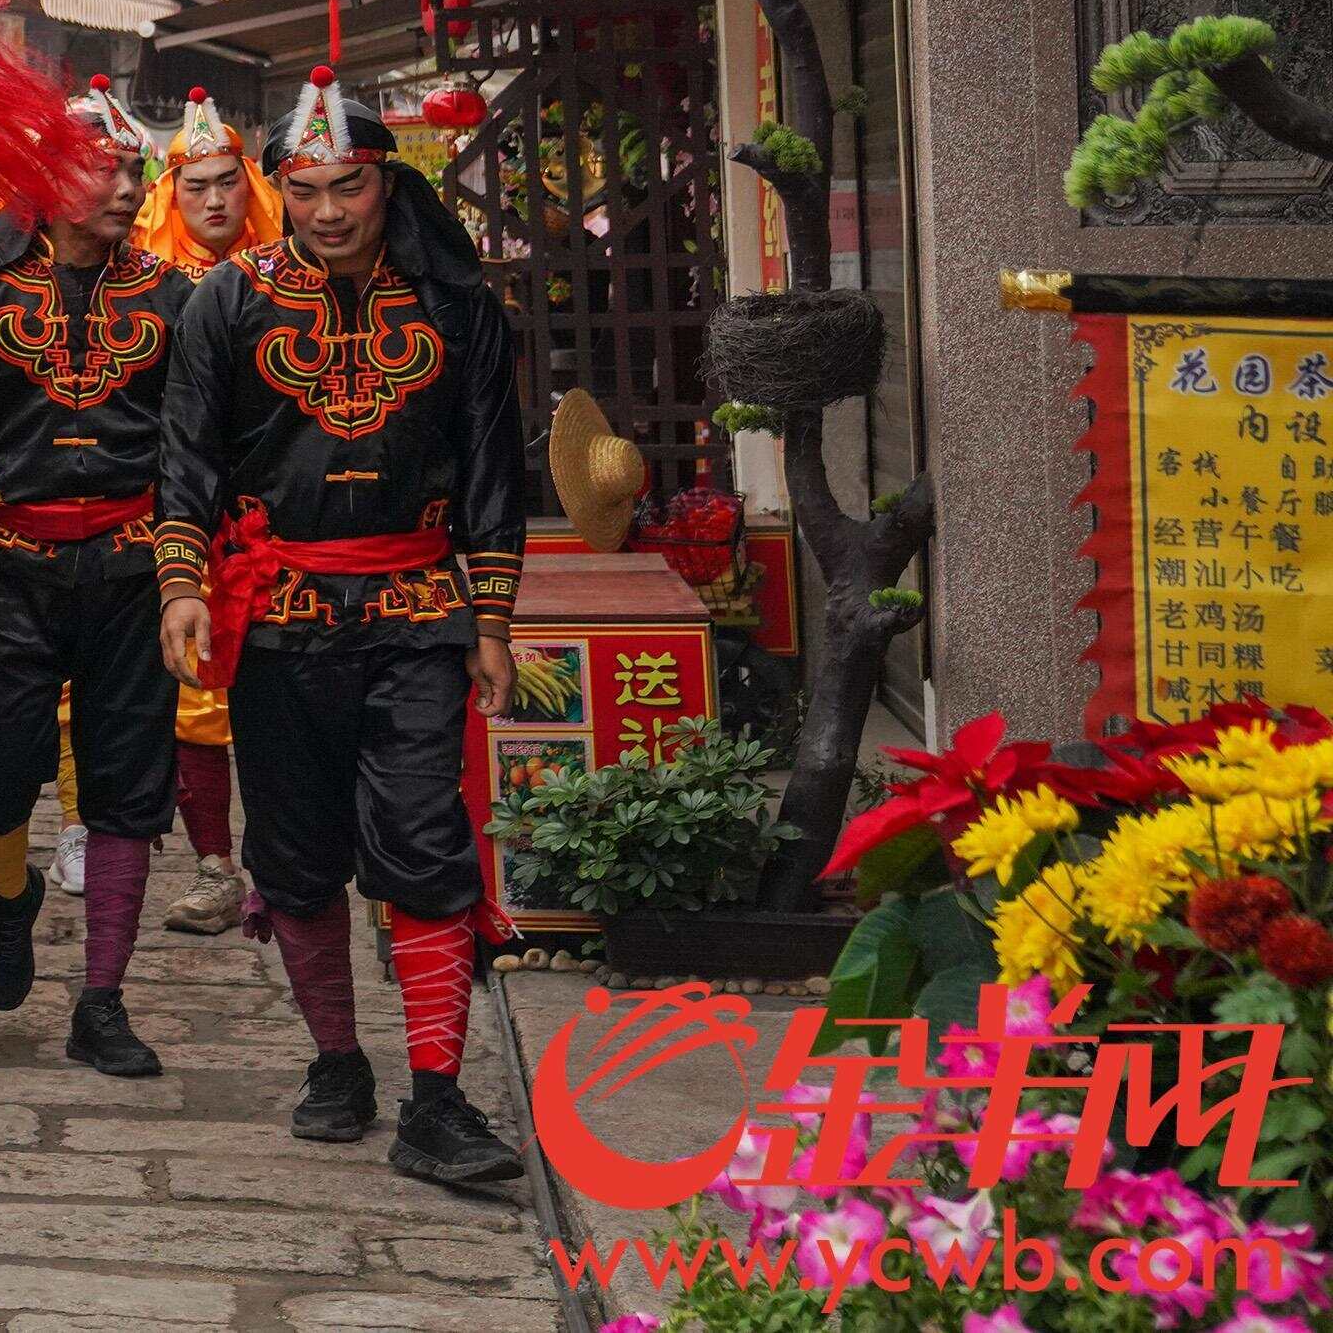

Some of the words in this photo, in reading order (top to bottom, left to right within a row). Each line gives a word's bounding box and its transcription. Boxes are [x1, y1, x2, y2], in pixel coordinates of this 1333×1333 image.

[1237, 404, 1327, 446] 内设
[1156, 446, 1221, 480] 客栈
[1154, 516, 1303, 553] 经营午餐
[1155, 556, 1304, 592] 潮汕小吃
[1156, 598, 1265, 633] 老鸡汤
